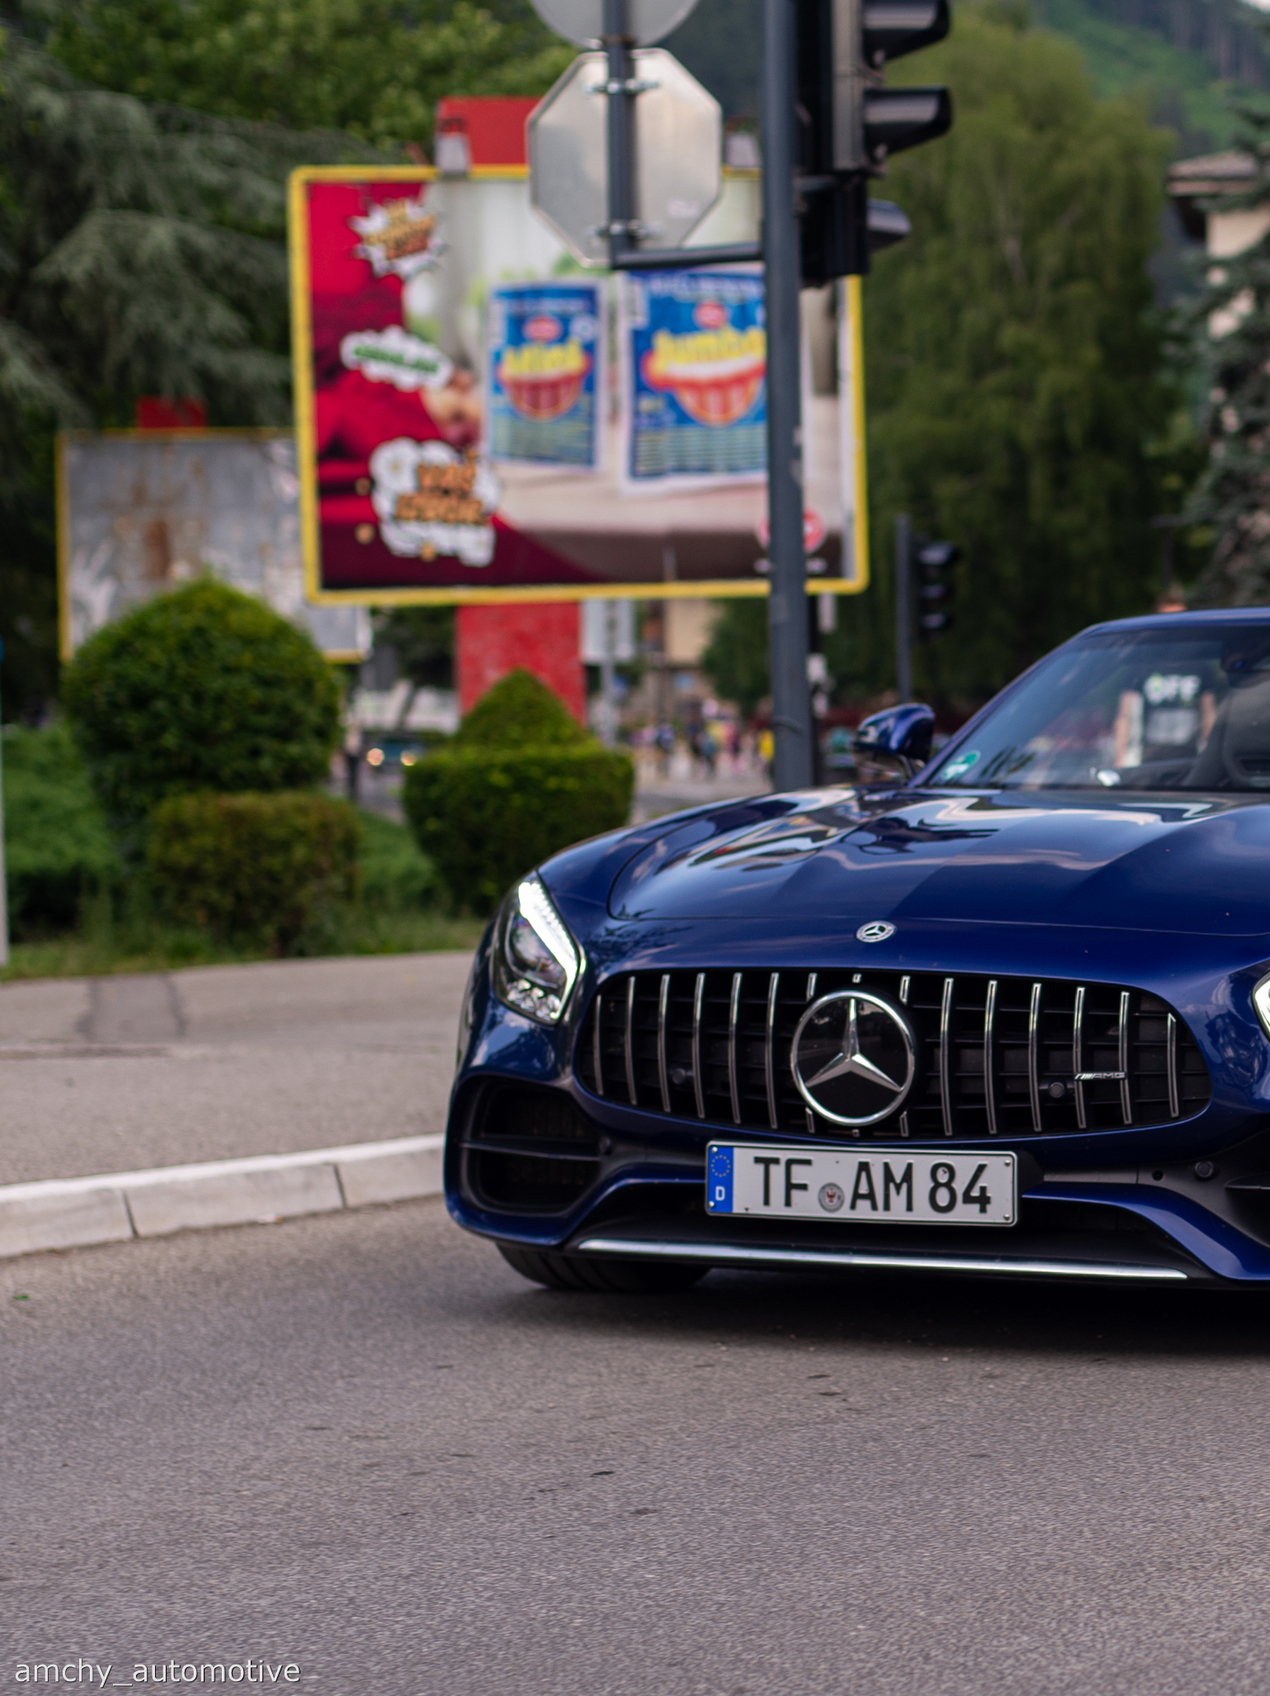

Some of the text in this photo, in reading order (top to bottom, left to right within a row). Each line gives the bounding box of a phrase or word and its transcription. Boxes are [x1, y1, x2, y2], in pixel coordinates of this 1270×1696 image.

[715, 1186, 725, 1201] D
[753, 1156, 991, 1214] TF AM 84
